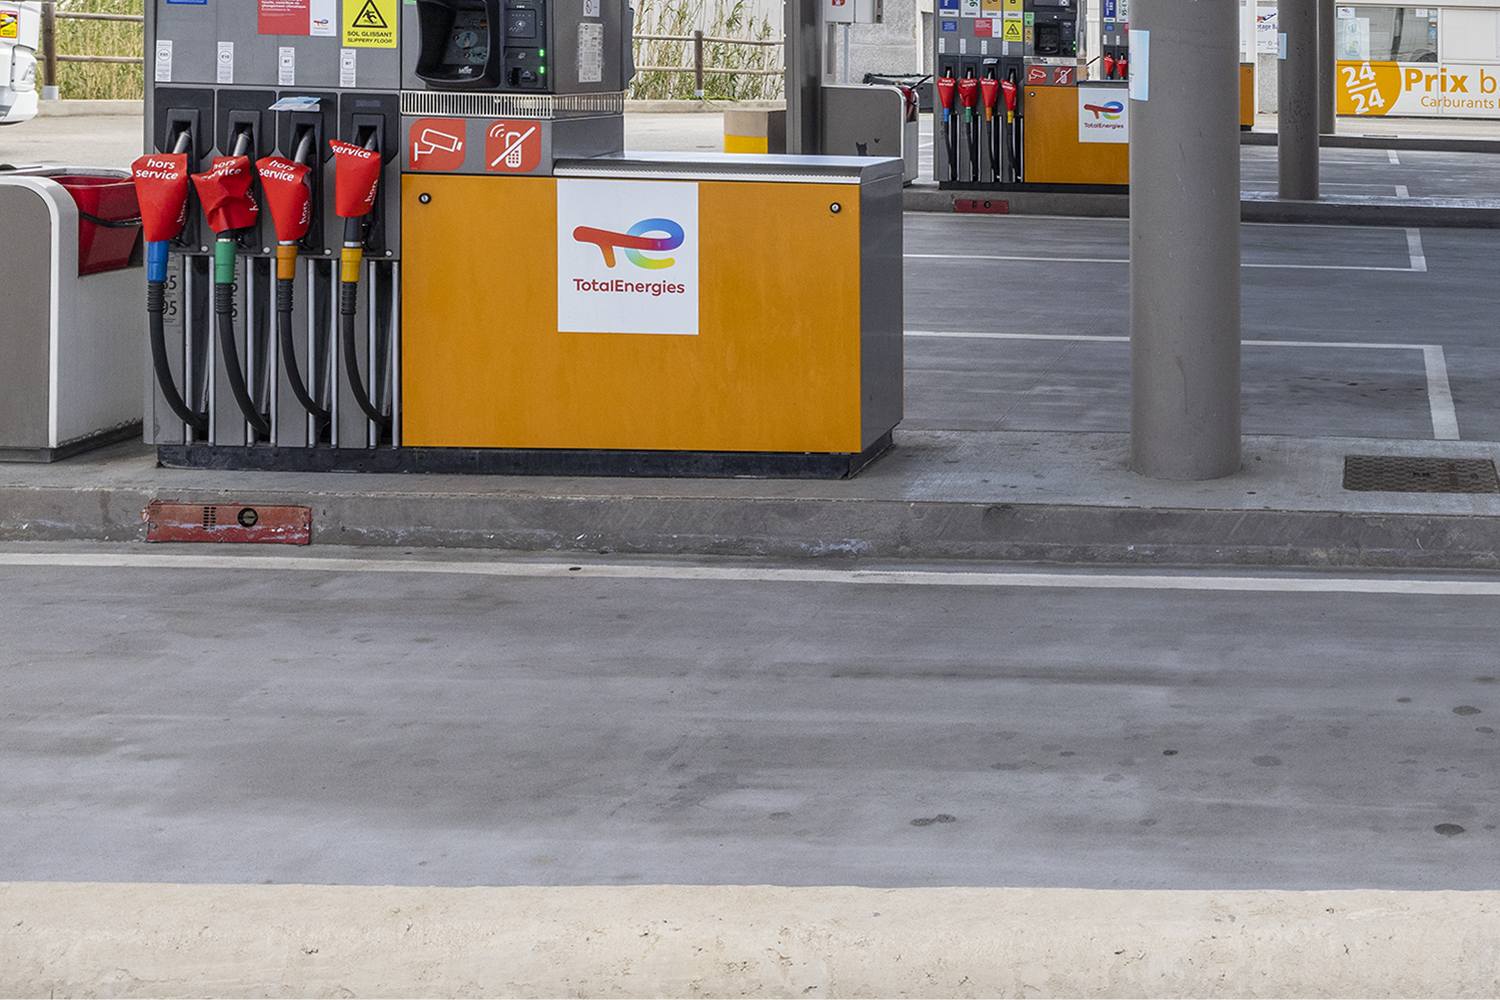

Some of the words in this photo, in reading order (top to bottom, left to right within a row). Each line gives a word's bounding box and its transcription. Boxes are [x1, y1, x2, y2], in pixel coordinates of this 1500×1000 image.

[1342, 62, 1376, 88] 24
[1404, 68, 1468, 93] Prix
[1350, 88, 1386, 114] 24
[1420, 96, 1494, 109] Carburants
[1084, 122, 1124, 130] TotalEnergies
[332, 145, 371, 158] service
[147, 158, 175, 170] hors
[268, 160, 296, 170] hors
[136, 169, 178, 180] service
[259, 168, 294, 182] service
[364, 180, 378, 202] hors
[573, 278, 685, 296] TotalEnergies
